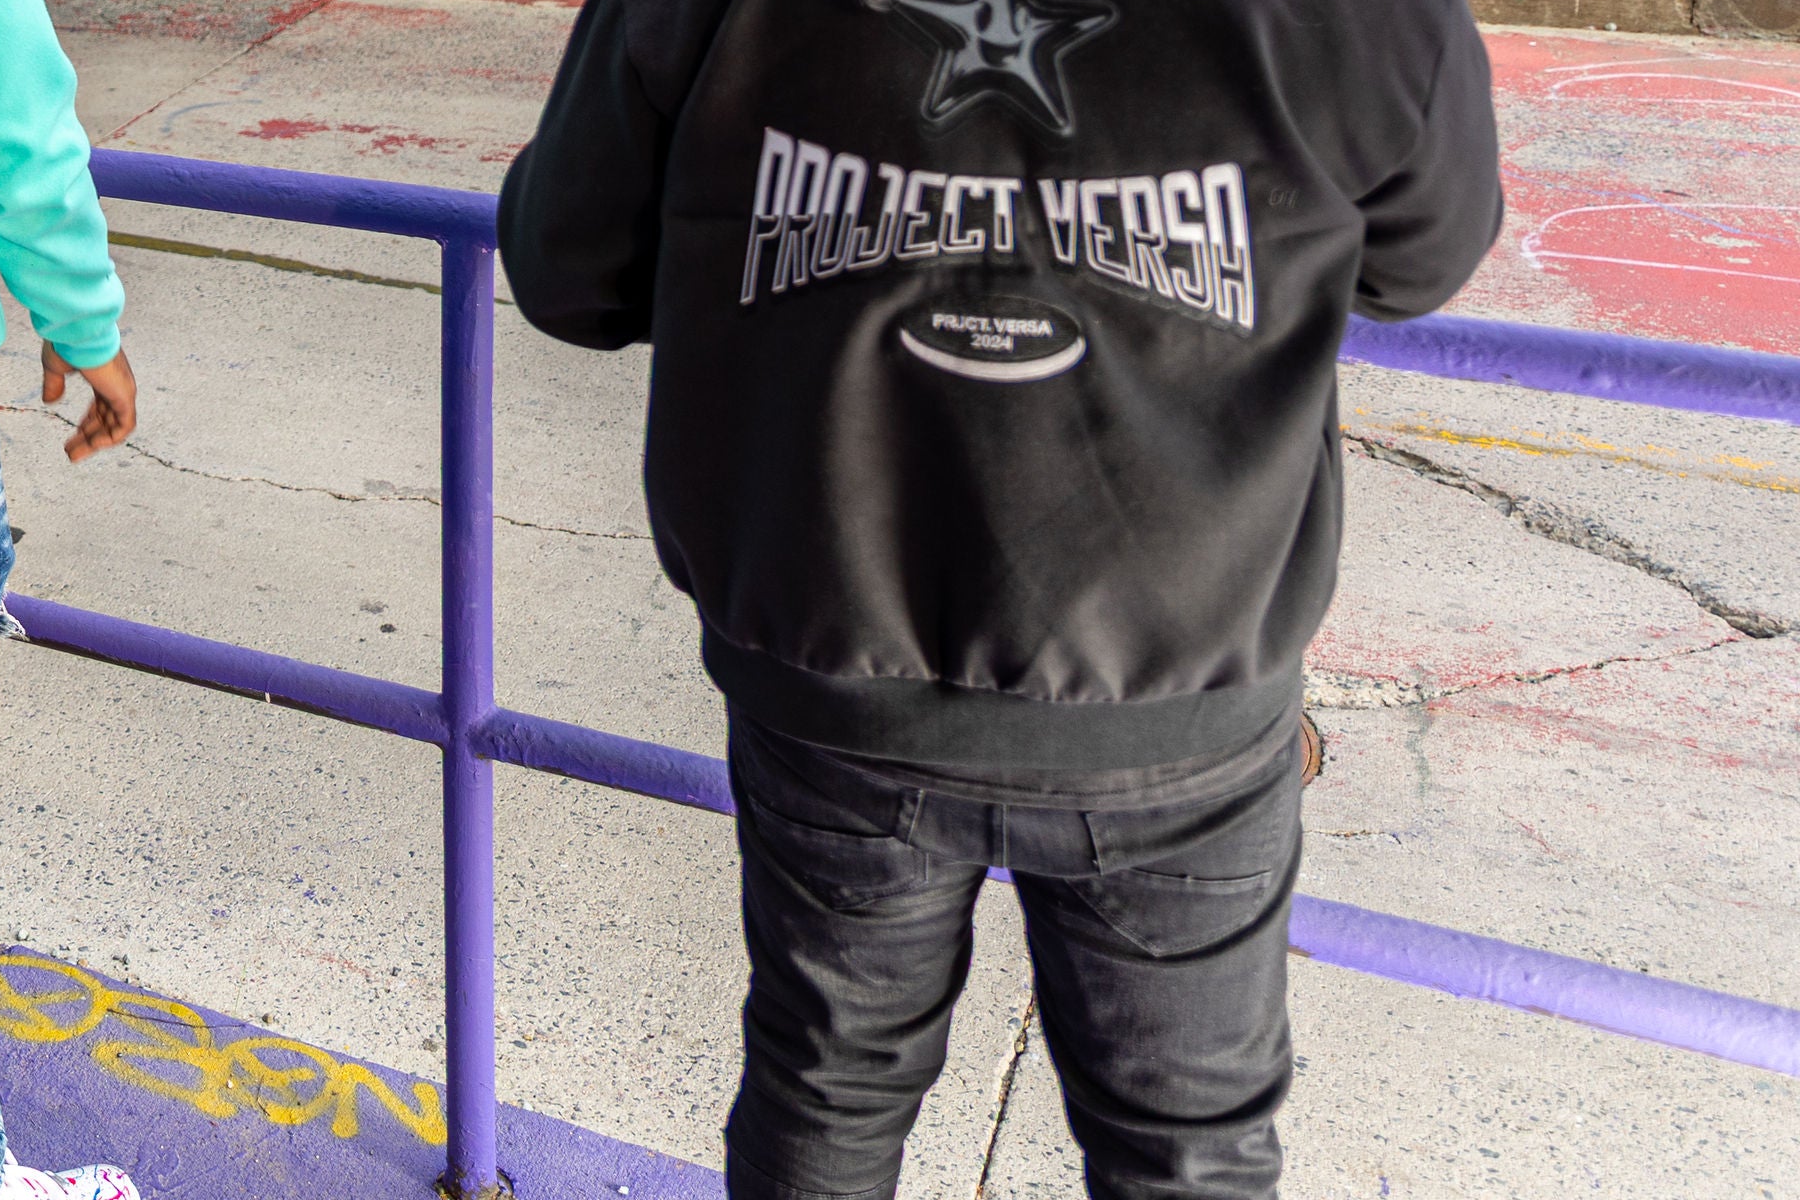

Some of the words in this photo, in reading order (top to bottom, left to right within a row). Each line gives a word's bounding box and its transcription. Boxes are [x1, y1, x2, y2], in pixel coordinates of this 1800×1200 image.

[739, 126, 1022, 305] PROJECT
[1037, 161, 1255, 331] VERSA
[993, 317, 1054, 338] VERSA
[969, 333, 1014, 353] 2024
